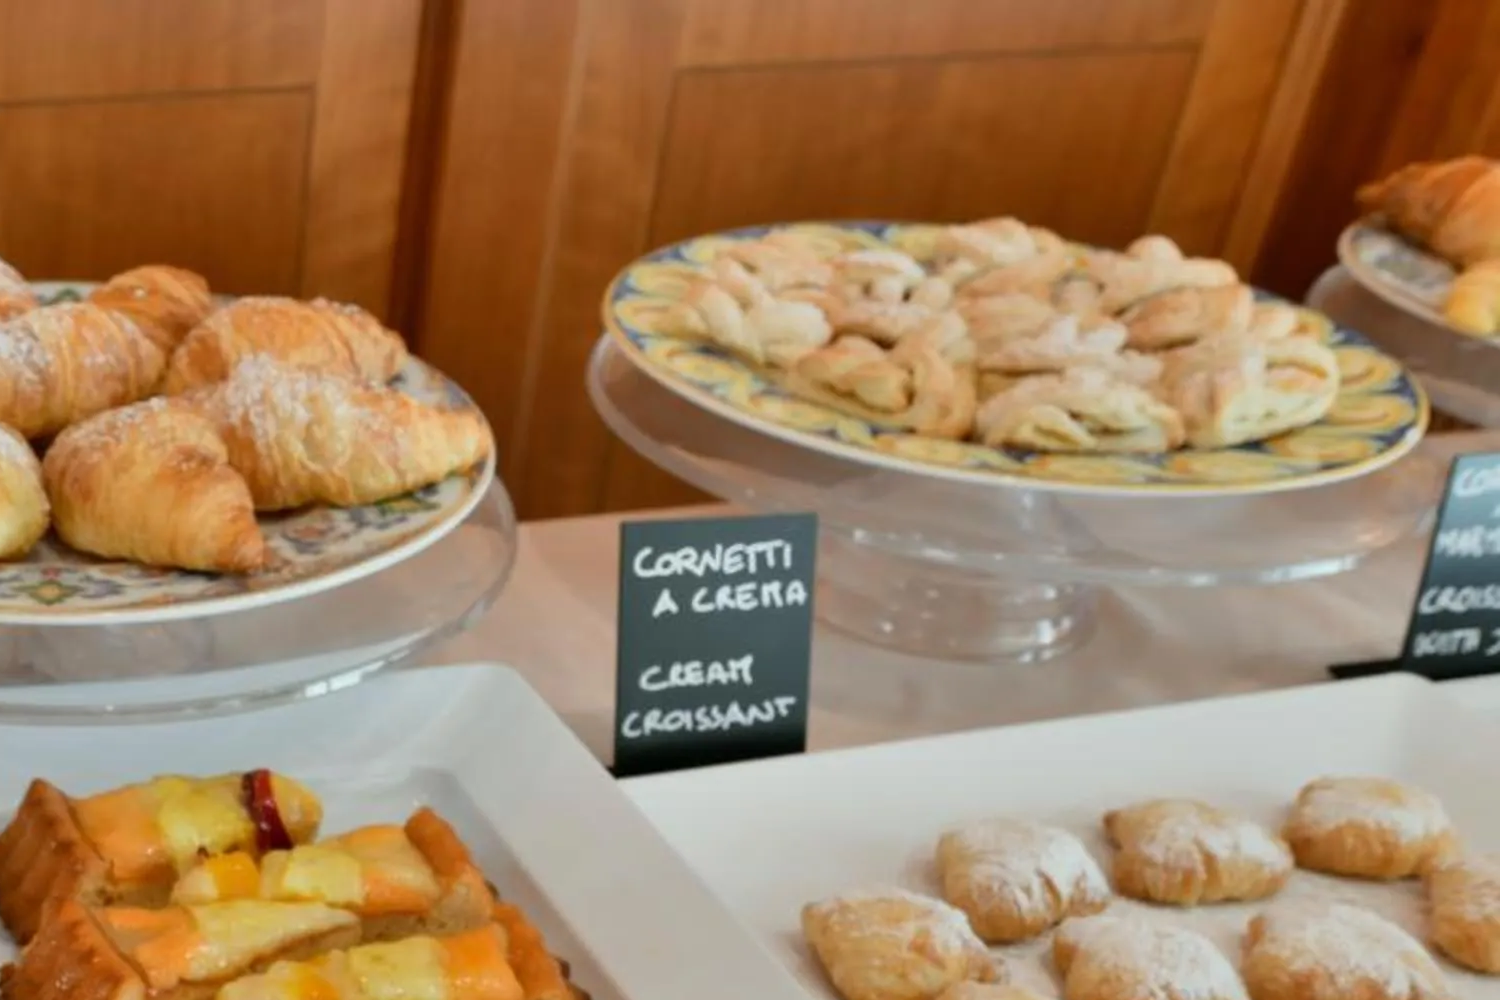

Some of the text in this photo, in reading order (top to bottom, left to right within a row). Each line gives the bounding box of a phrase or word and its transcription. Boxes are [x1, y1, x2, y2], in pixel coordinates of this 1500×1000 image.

[633, 539, 793, 579] CORNETTI
[652, 579, 808, 618] A CREMA
[638, 654, 754, 691] CREAM
[621, 696, 797, 738] CROISSANT
